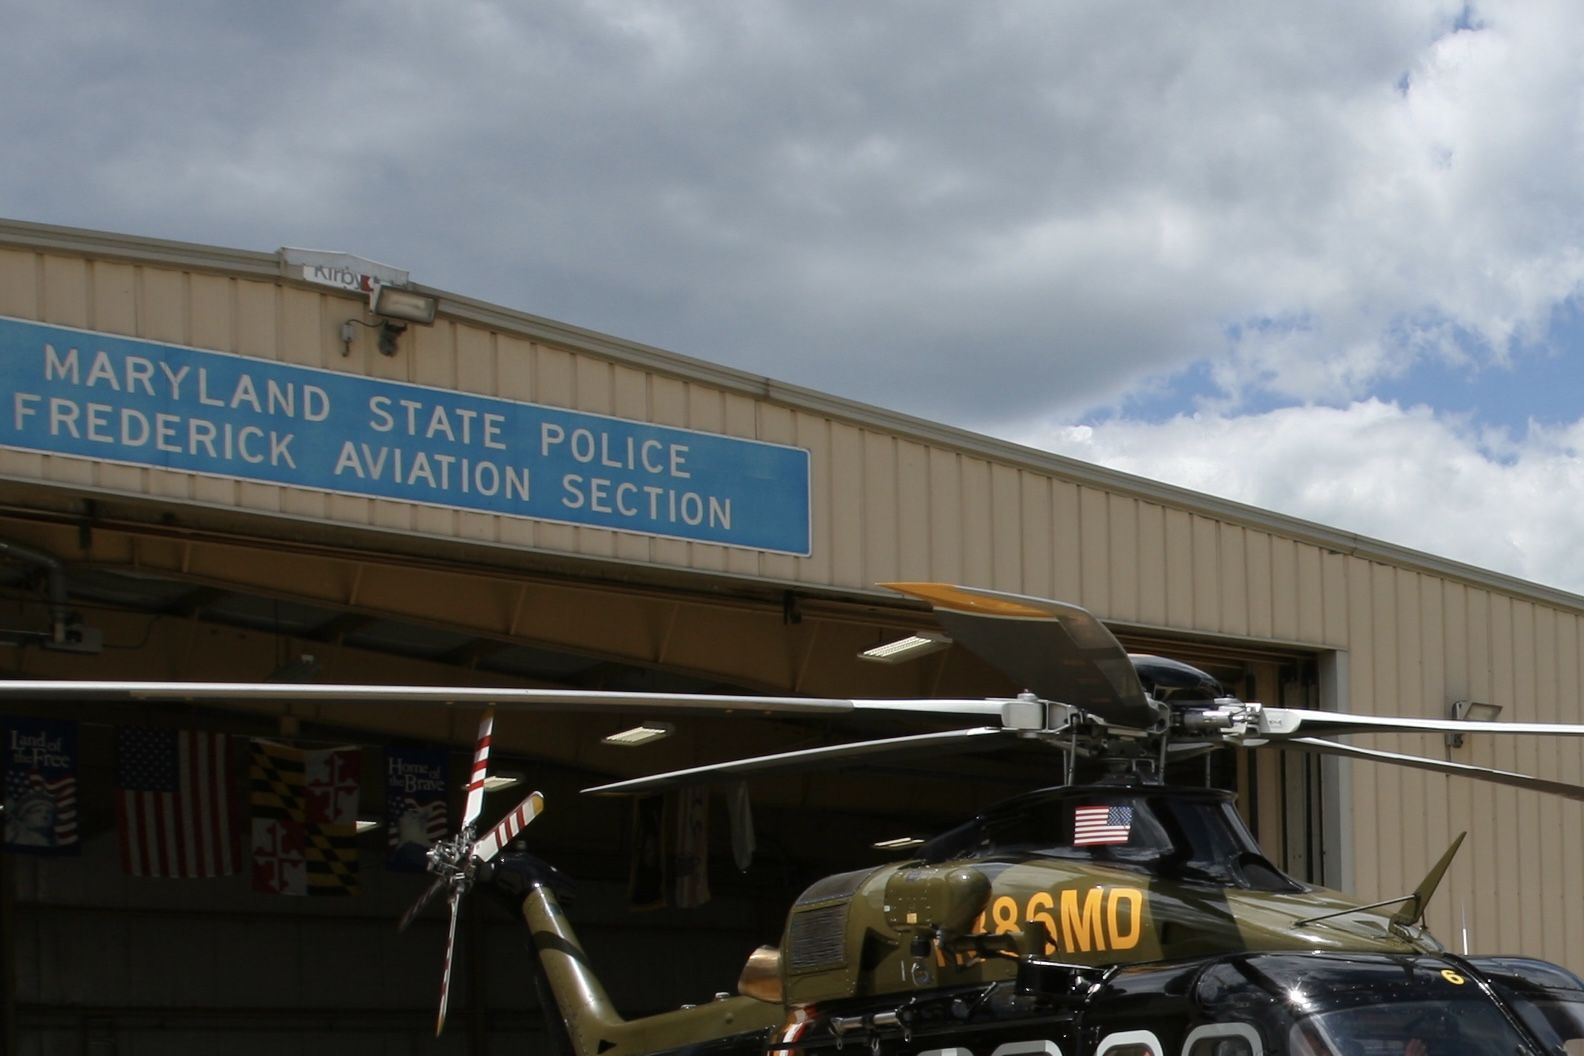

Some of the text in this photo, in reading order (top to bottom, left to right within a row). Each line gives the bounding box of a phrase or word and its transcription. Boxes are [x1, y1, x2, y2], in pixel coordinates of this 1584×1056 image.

[314, 265, 363, 290] Kirby
[44, 344, 691, 479] MARYLAND STATE POLICE
[15, 393, 732, 531] FREDERICK AVIATION SECTION
[11, 729, 63, 752] Land of
[32, 747, 71, 769] Free
[388, 757, 431, 775] Home
[404, 774, 447, 793] Brave
[1441, 969, 1464, 985] 6
